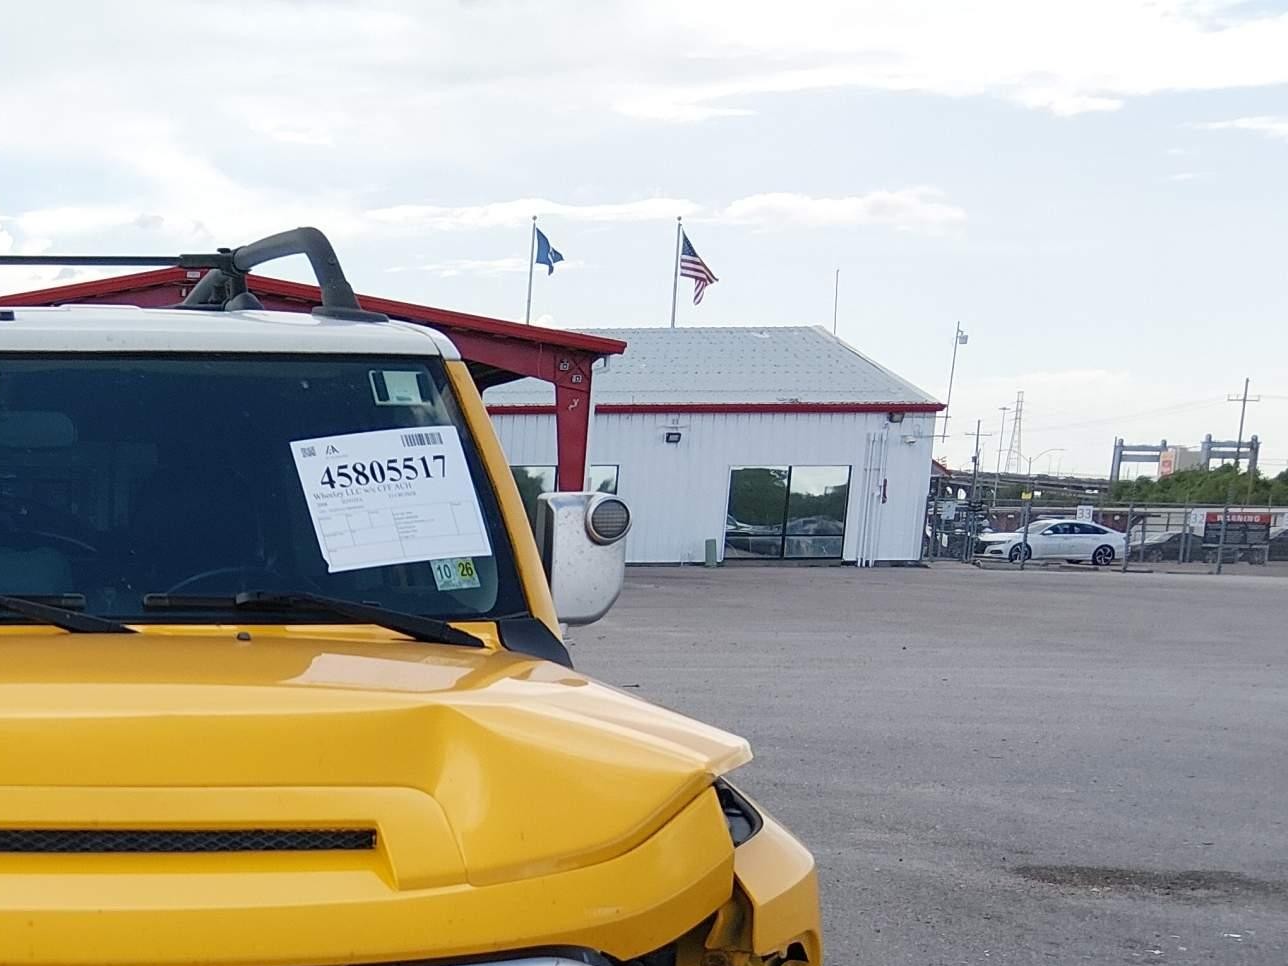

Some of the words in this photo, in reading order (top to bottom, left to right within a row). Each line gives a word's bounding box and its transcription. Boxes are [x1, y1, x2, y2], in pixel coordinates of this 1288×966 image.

[320, 455, 445, 488] 45805517
[437, 564, 452, 579] 10
[458, 562, 474, 577] 26
